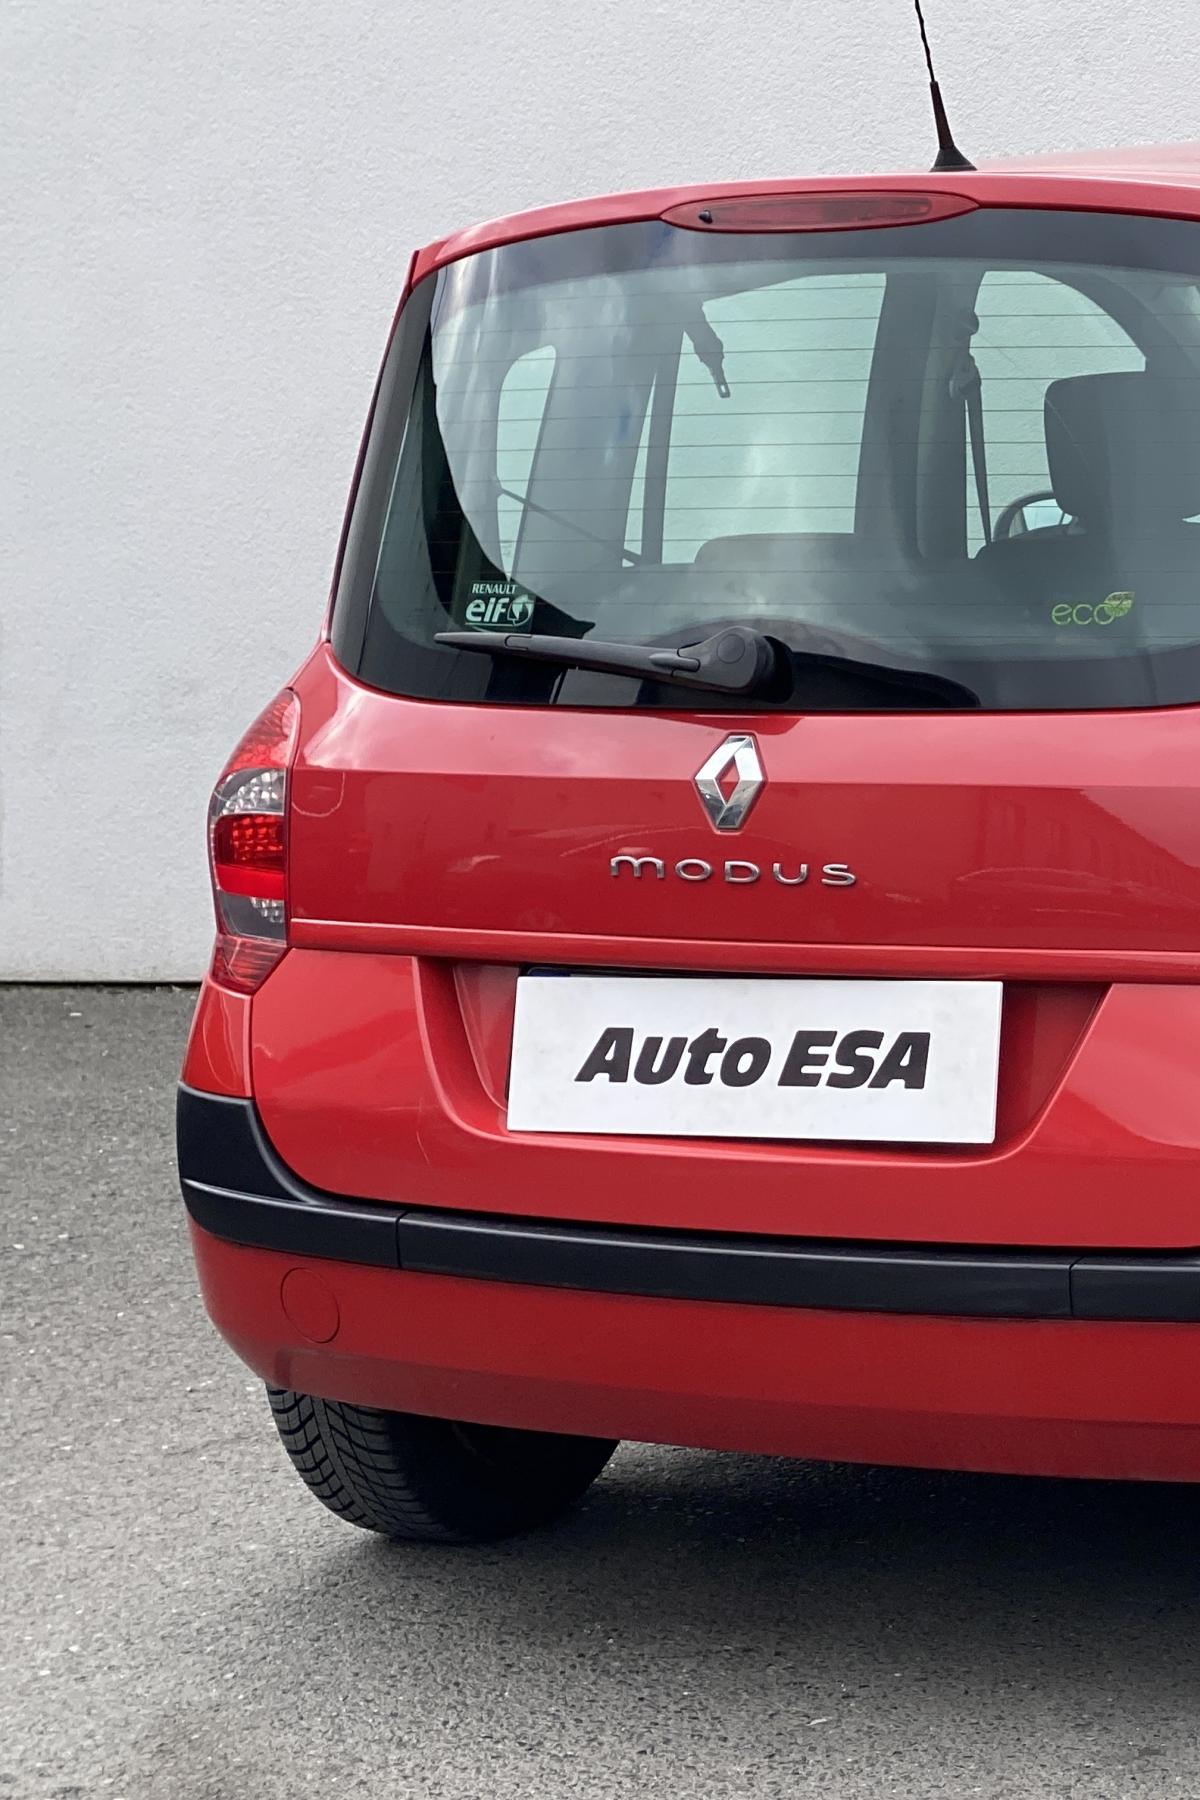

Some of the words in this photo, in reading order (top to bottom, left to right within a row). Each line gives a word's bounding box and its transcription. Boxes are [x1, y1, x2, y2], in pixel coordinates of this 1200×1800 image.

[472, 583, 517, 594] RENAULT
[465, 597, 510, 622] elf
[1052, 604, 1115, 625] eco
[574, 1027, 772, 1087] Auto
[777, 1030, 931, 1089] ESA
